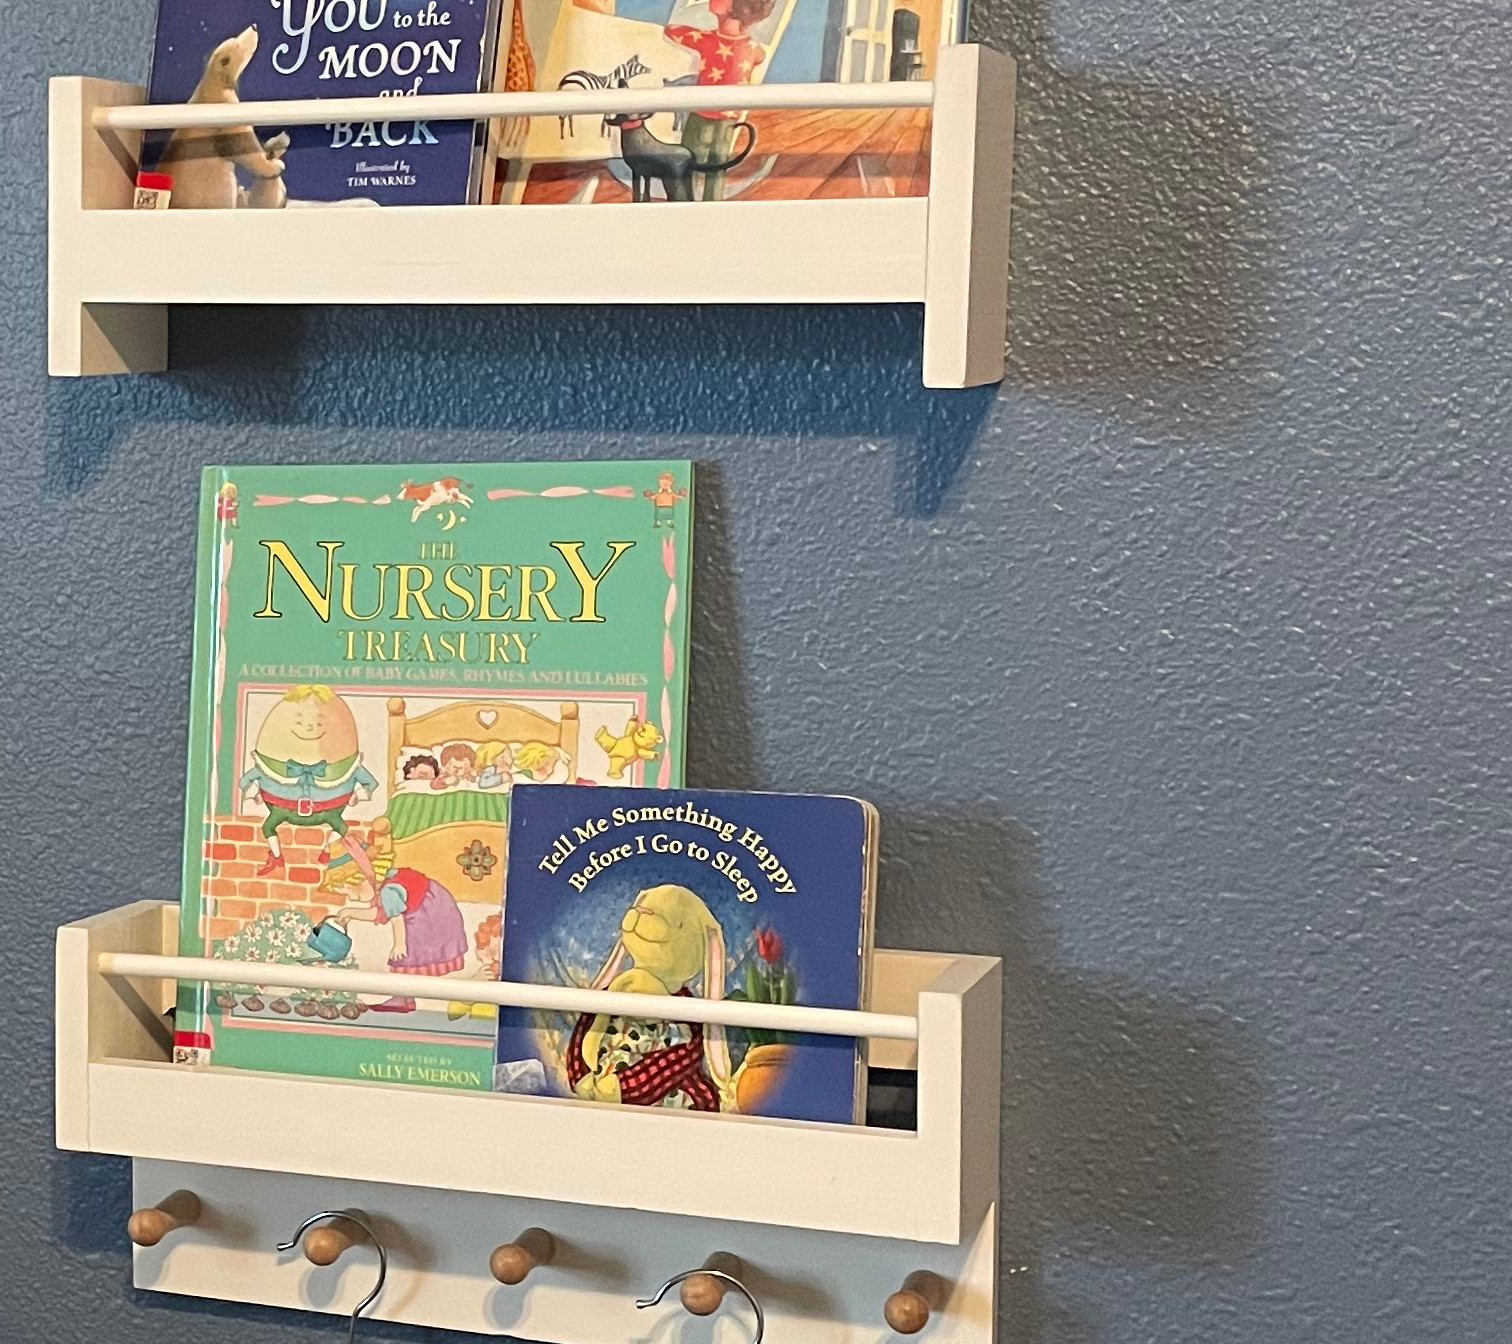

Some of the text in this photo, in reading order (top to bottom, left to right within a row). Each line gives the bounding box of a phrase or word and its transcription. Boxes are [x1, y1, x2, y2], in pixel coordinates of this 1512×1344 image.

[393, 10, 413, 28] to
[417, 0, 451, 27] the
[319, 38, 462, 80] MOON
[325, 120, 439, 148] BACK
[400, 160, 410, 173] by
[347, 175, 417, 187] TIM WARNES
[253, 539, 637, 624] NURSERY
[338, 630, 540, 665] TREASURY
[239, 664, 249, 676] A
[344, 666, 362, 679] OF
[366, 666, 402, 680] BABY
[463, 668, 524, 684] RHYMES
[528, 669, 562, 684] AND
[566, 670, 649, 686] LULLABIES
[538, 801, 797, 893] Tell Me Something Happy
[568, 834, 758, 903] Before I Go to Sleep
[359, 1062, 480, 1086] SALLY EMERSON
